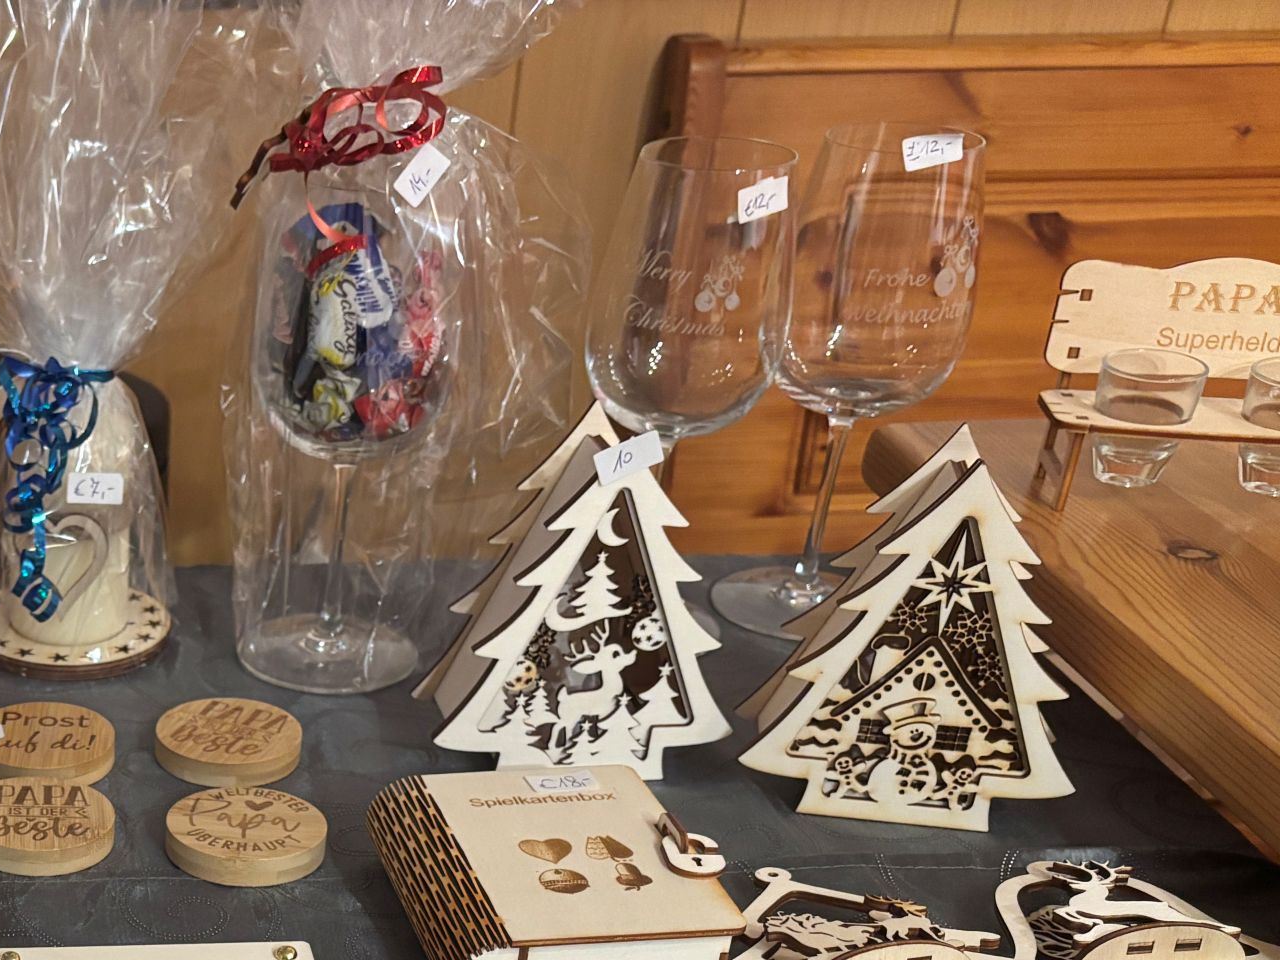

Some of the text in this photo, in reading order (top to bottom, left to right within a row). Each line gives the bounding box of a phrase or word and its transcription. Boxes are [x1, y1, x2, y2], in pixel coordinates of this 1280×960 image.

[862, 267, 931, 289] Frohe
[1168, 280, 1280, 316] PAPA
[1, 709, 93, 729] Prost
[200, 700, 291, 735] PAPA
[50, 733, 95, 753] di!
[170, 718, 271, 756] Beste
[7, 806, 69, 817] IST DER
[208, 785, 310, 814] WELTBESTER
[468, 792, 618, 810] Spielkartenbox
[182, 797, 302, 839] Papa
